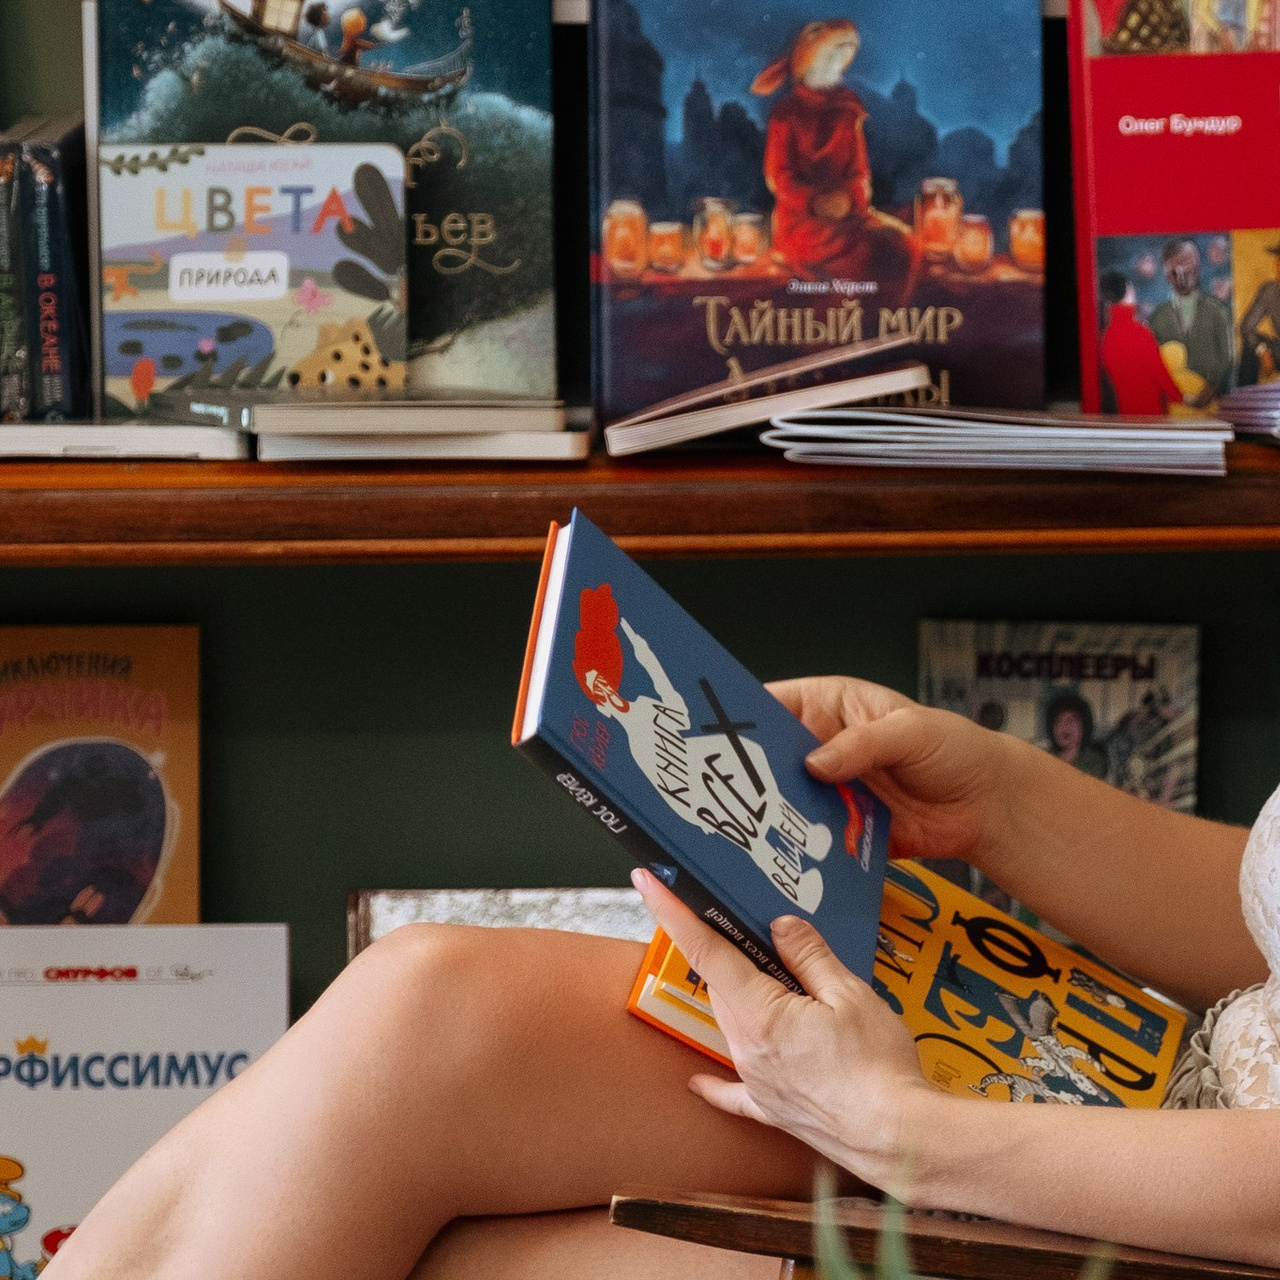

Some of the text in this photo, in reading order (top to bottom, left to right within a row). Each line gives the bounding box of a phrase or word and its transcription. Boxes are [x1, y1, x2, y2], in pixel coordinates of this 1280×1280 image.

[1118, 116, 1166, 135] Олег
[155, 186, 355, 239] ЦВЕТА
[179, 267, 280, 288] ПРИРОДА
[38, 291, 61, 372] ОКЕАНЕ
[977, 651, 1156, 681] КОСПЛЕЕРЫ
[652, 701, 693, 809] КНИГА
[591, 805, 629, 836] ГЮС
[770, 801, 815, 902] ВЕЩЕЙ
[703, 906, 746, 945] вещей
[741, 940, 769, 970] всех
[43, 966, 138, 980] СМУРФОВ
